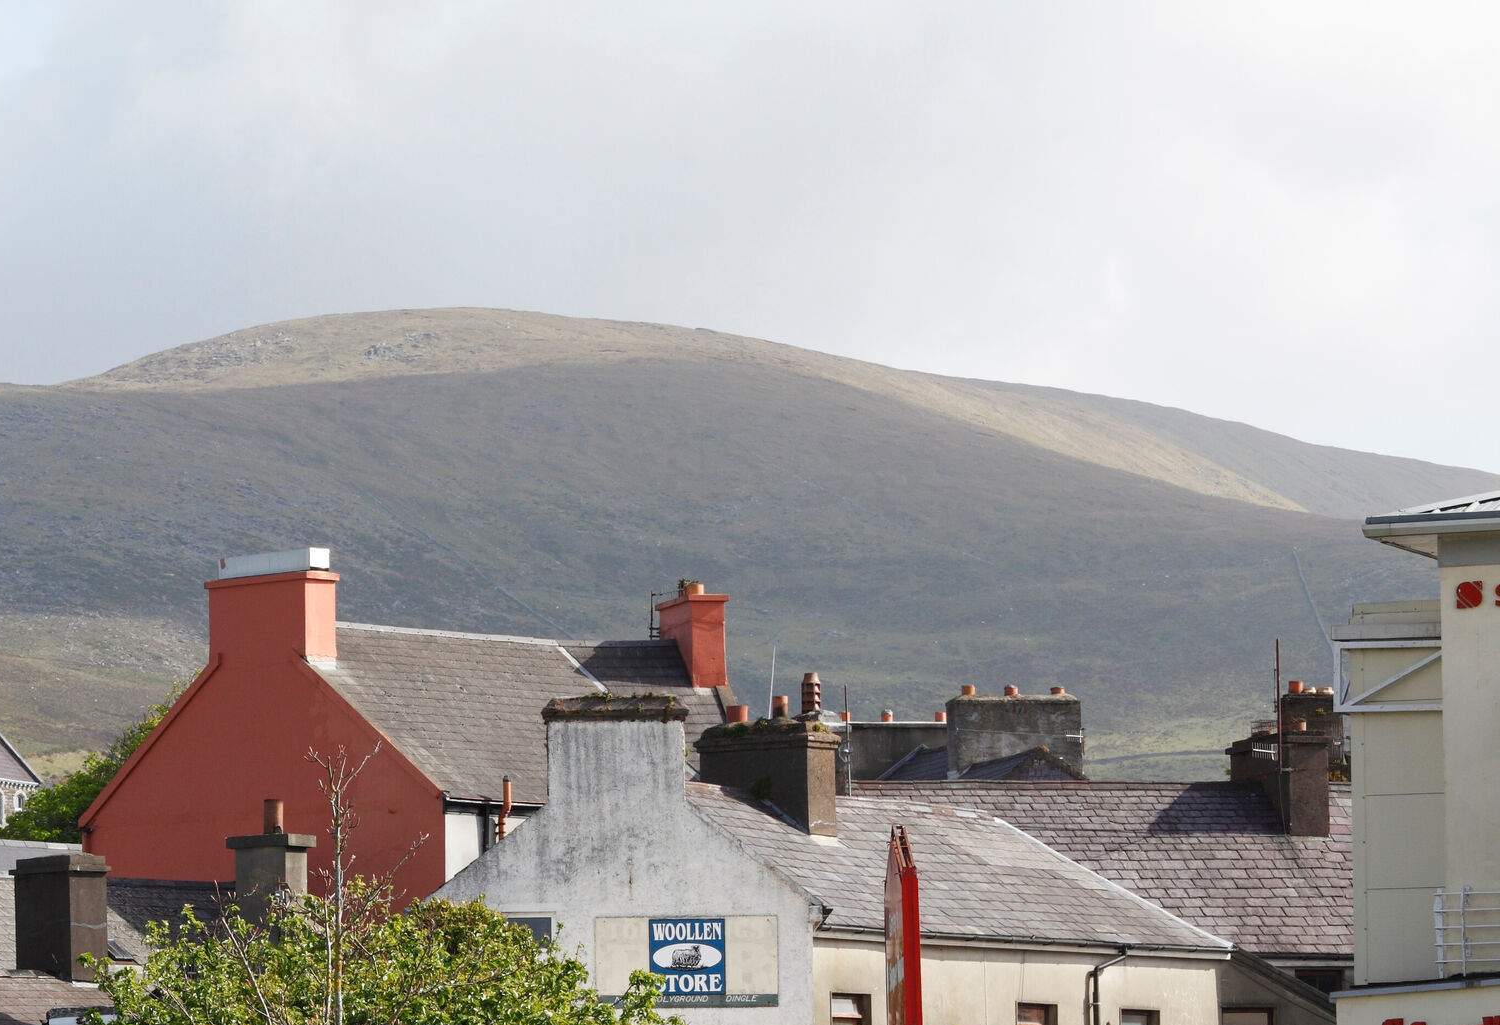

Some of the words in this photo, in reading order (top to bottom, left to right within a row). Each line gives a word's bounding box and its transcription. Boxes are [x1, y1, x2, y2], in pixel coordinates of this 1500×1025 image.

[652, 922, 722, 941] WOOLLEN
[653, 995, 709, 1003] OLYGROUND
[725, 994, 758, 1003] DINGLE
